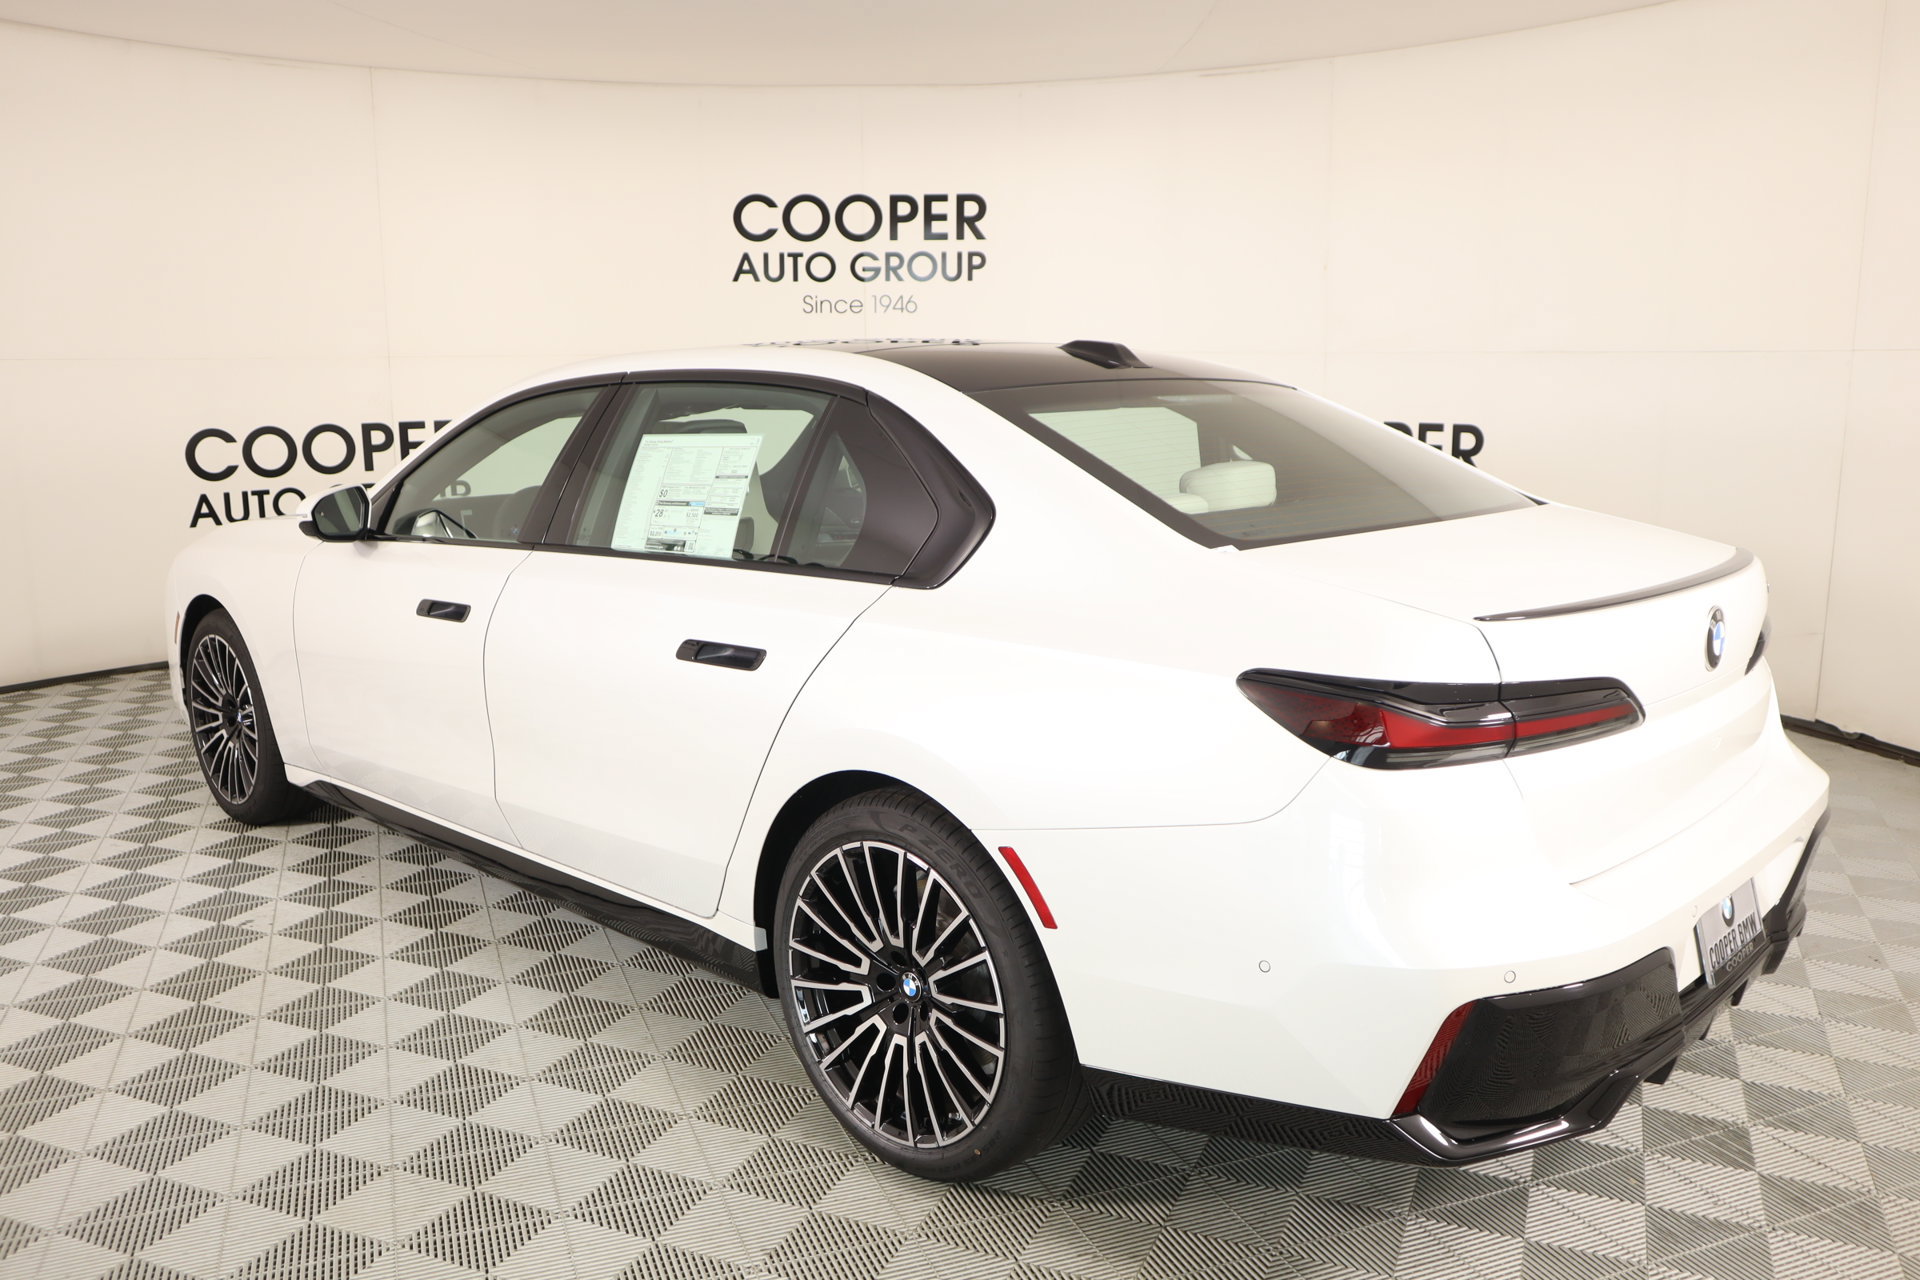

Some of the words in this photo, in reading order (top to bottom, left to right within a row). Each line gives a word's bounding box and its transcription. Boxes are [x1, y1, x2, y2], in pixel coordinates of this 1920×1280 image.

[733, 193, 987, 242] COOPER
[732, 251, 836, 282] AUTO
[850, 251, 987, 282] GROUP
[802, 294, 864, 314] Since
[871, 294, 918, 314] 1946
[185, 419, 453, 482] COOPE
[189, 487, 307, 528] AUTO
[1708, 929, 1739, 970] COOPER
[1737, 911, 1758, 944] BMW
[1726, 942, 1754, 972] COOPER
